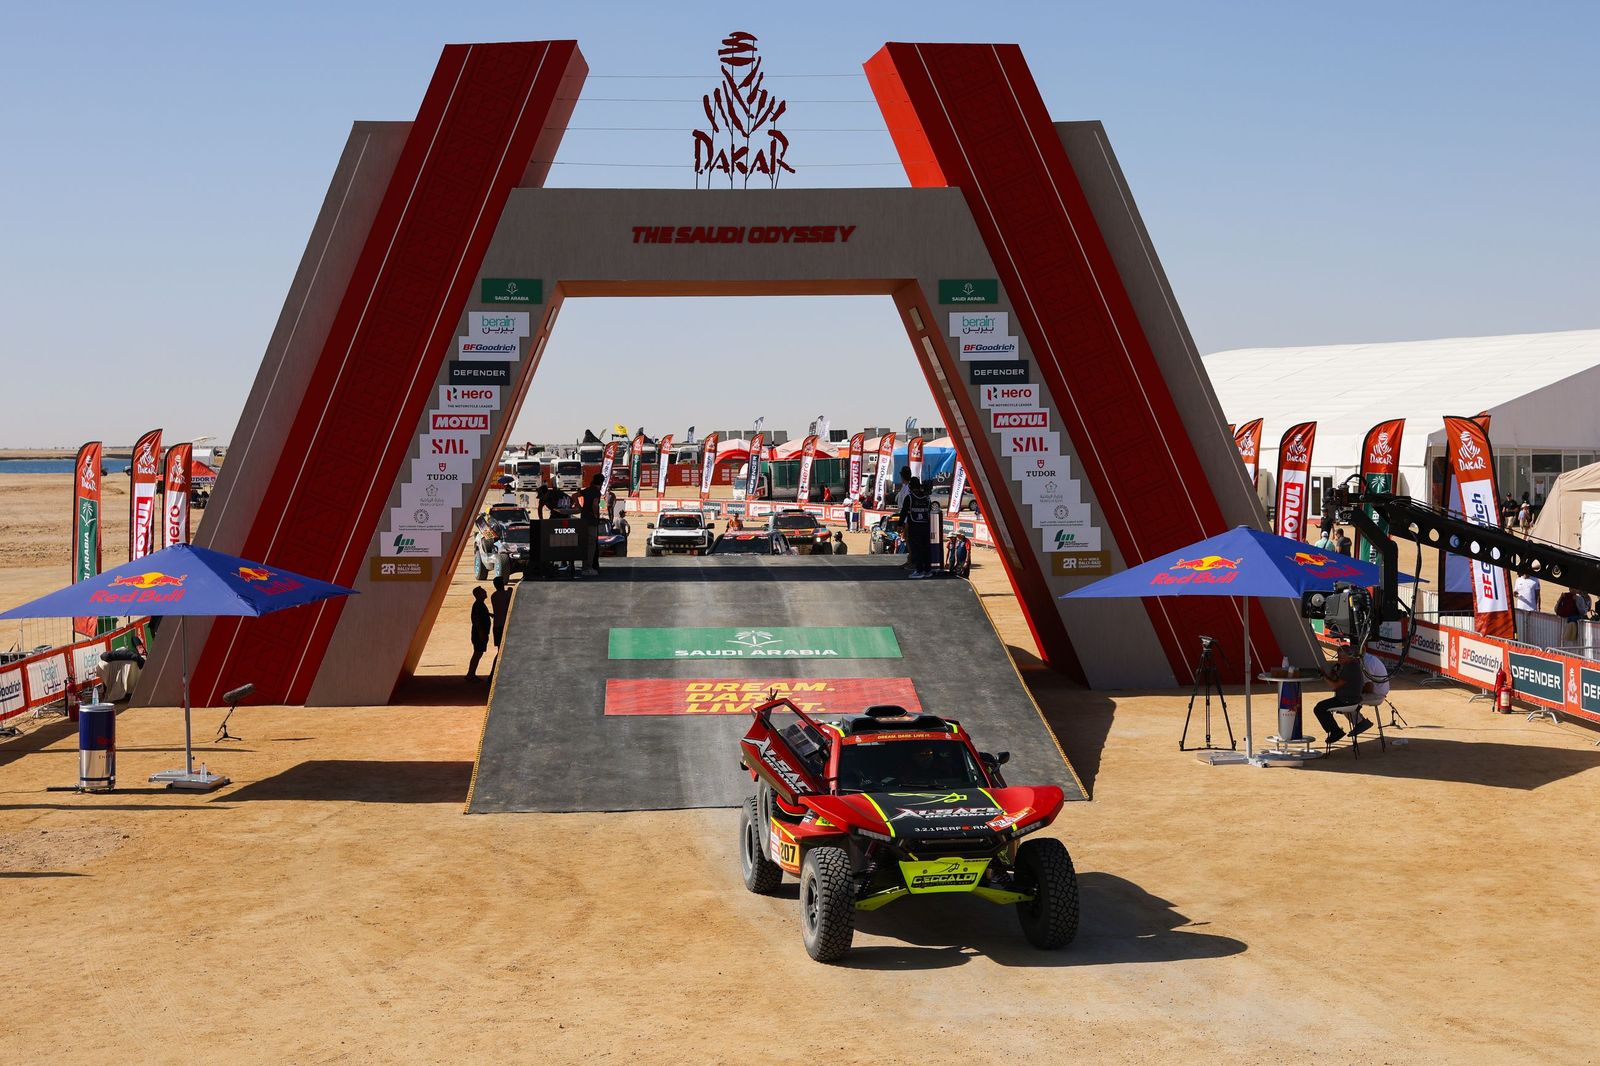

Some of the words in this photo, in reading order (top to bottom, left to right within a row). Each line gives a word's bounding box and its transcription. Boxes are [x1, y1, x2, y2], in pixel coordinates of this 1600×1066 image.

[692, 129, 796, 175] DAKAR
[632, 225, 675, 244] THE
[674, 225, 746, 244] SAUDI
[747, 225, 857, 244] ODYSSEY
[481, 315, 515, 327] berain
[962, 315, 994, 327] berain
[463, 343, 516, 351] BFGoodrich
[963, 343, 1015, 351] BFGoodrich
[453, 369, 506, 377] DEFENDER
[974, 368, 1025, 376] DEFENDER
[435, 416, 486, 428] MOTUL
[995, 414, 1045, 426] MOTUL
[1286, 453, 1308, 463] DAKAR
[1369, 453, 1393, 465] DAKAR
[1458, 459, 1487, 471] DAKAR
[1150, 572, 1195, 585] Red
[1193, 571, 1239, 584] Bull
[89, 589, 137, 604] Red
[136, 589, 188, 604] Bull
[1462, 647, 1500, 670] BFGoodrich
[1511, 664, 1561, 690] DEFENDER
[685, 682, 836, 691] DREAM.
[780, 842, 796, 863] 207
[912, 873, 977, 884] CECCALDI
